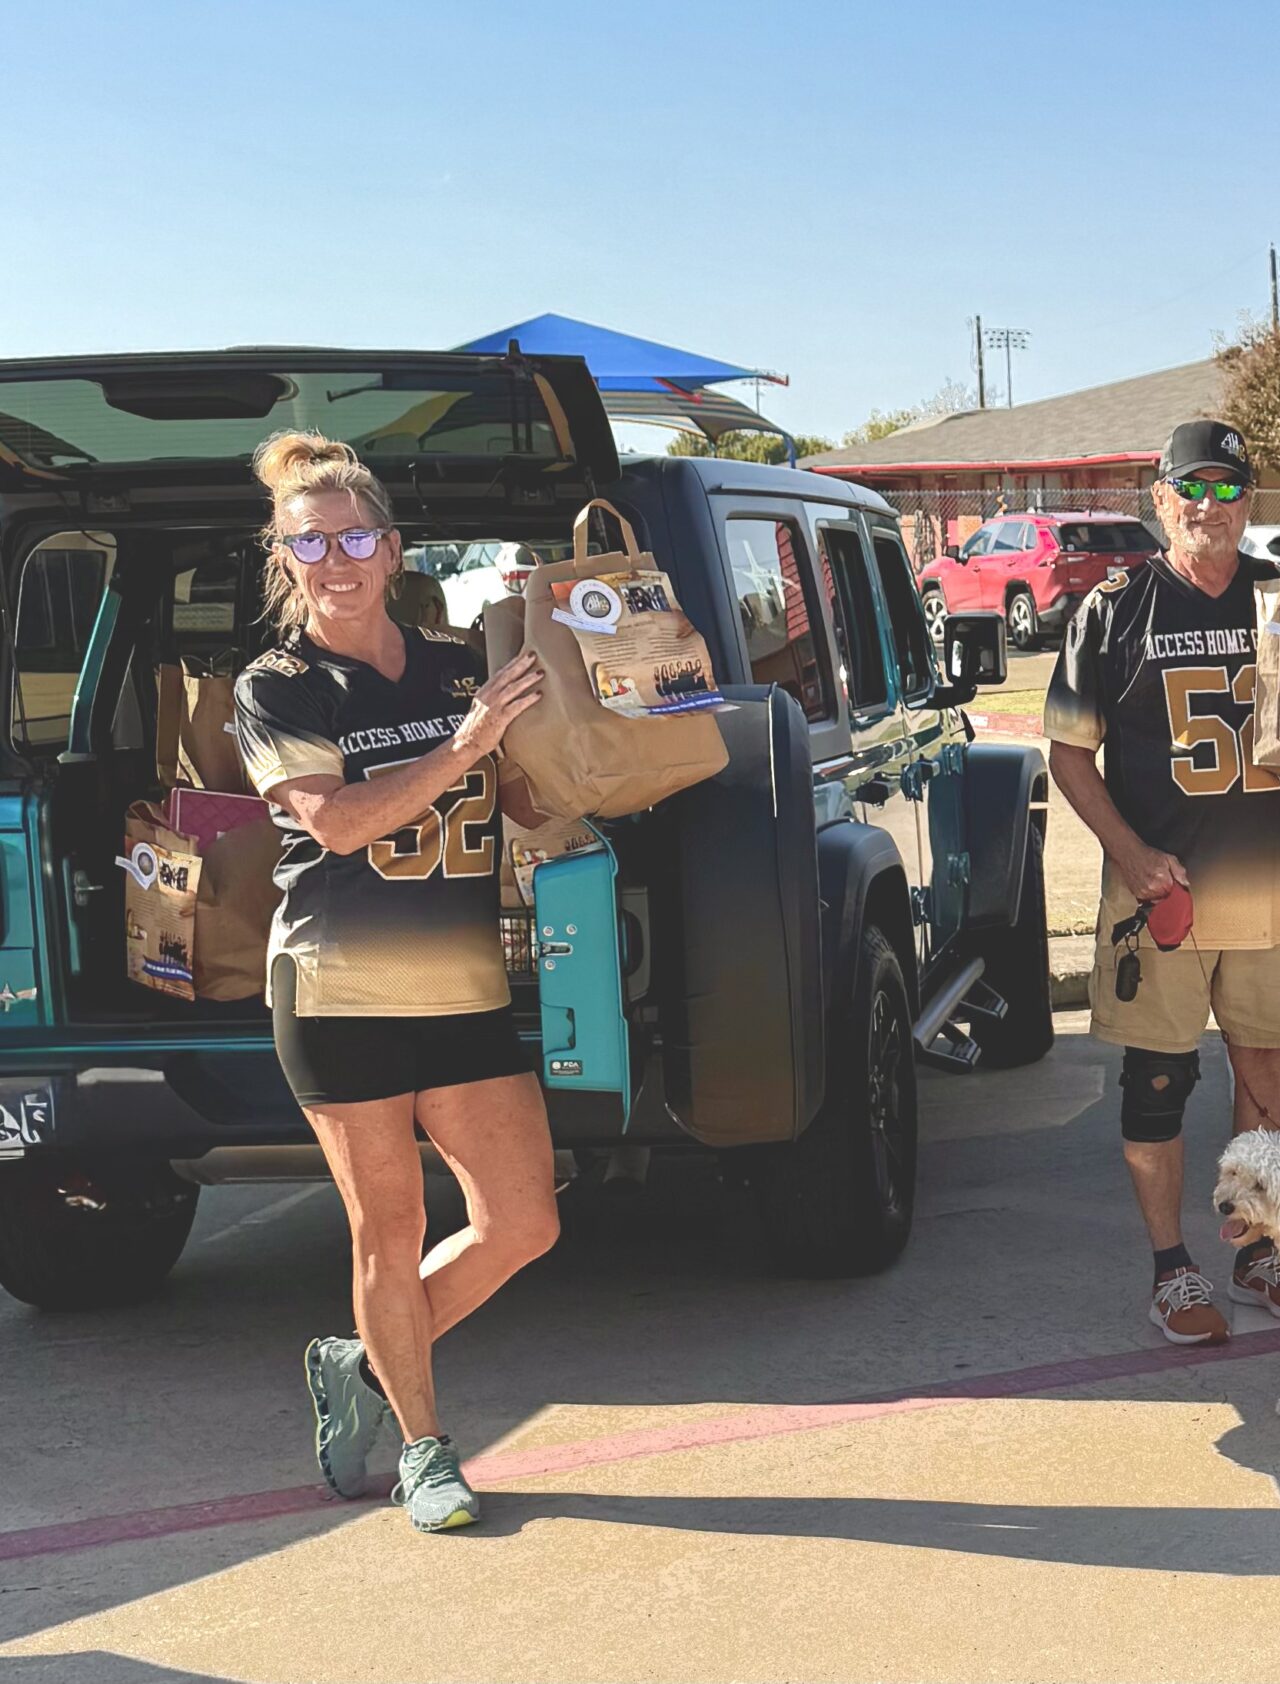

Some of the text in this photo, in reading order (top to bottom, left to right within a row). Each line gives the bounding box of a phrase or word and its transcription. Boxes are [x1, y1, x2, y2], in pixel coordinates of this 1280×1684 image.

[1146, 631, 1205, 660] ACCESS
[1205, 628, 1251, 655] HOME
[338, 728, 402, 755] ACCESS
[398, 717, 450, 742] HOME
